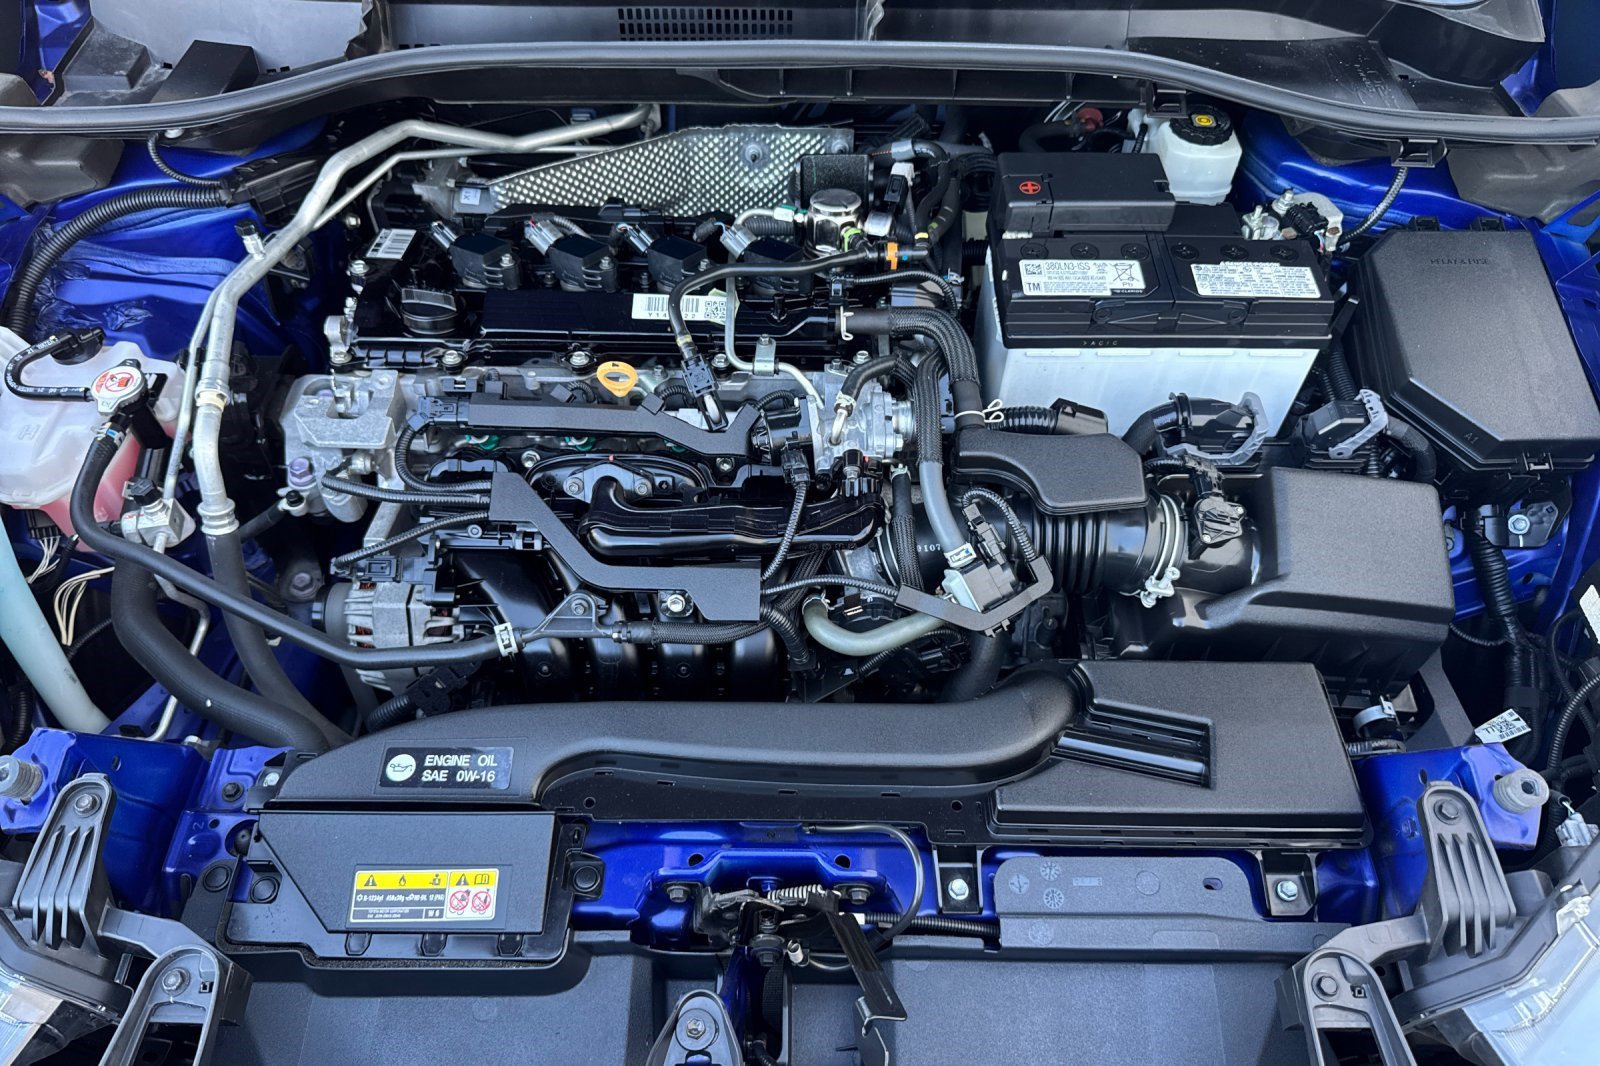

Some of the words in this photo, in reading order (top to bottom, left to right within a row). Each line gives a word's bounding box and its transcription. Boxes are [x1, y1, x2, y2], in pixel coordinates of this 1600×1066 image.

[1026, 282, 1041, 292] TM
[423, 754, 471, 767] ENGINE
[477, 754, 498, 767] OIL
[421, 769, 448, 782] SAE
[455, 770, 496, 783] 0W-16
